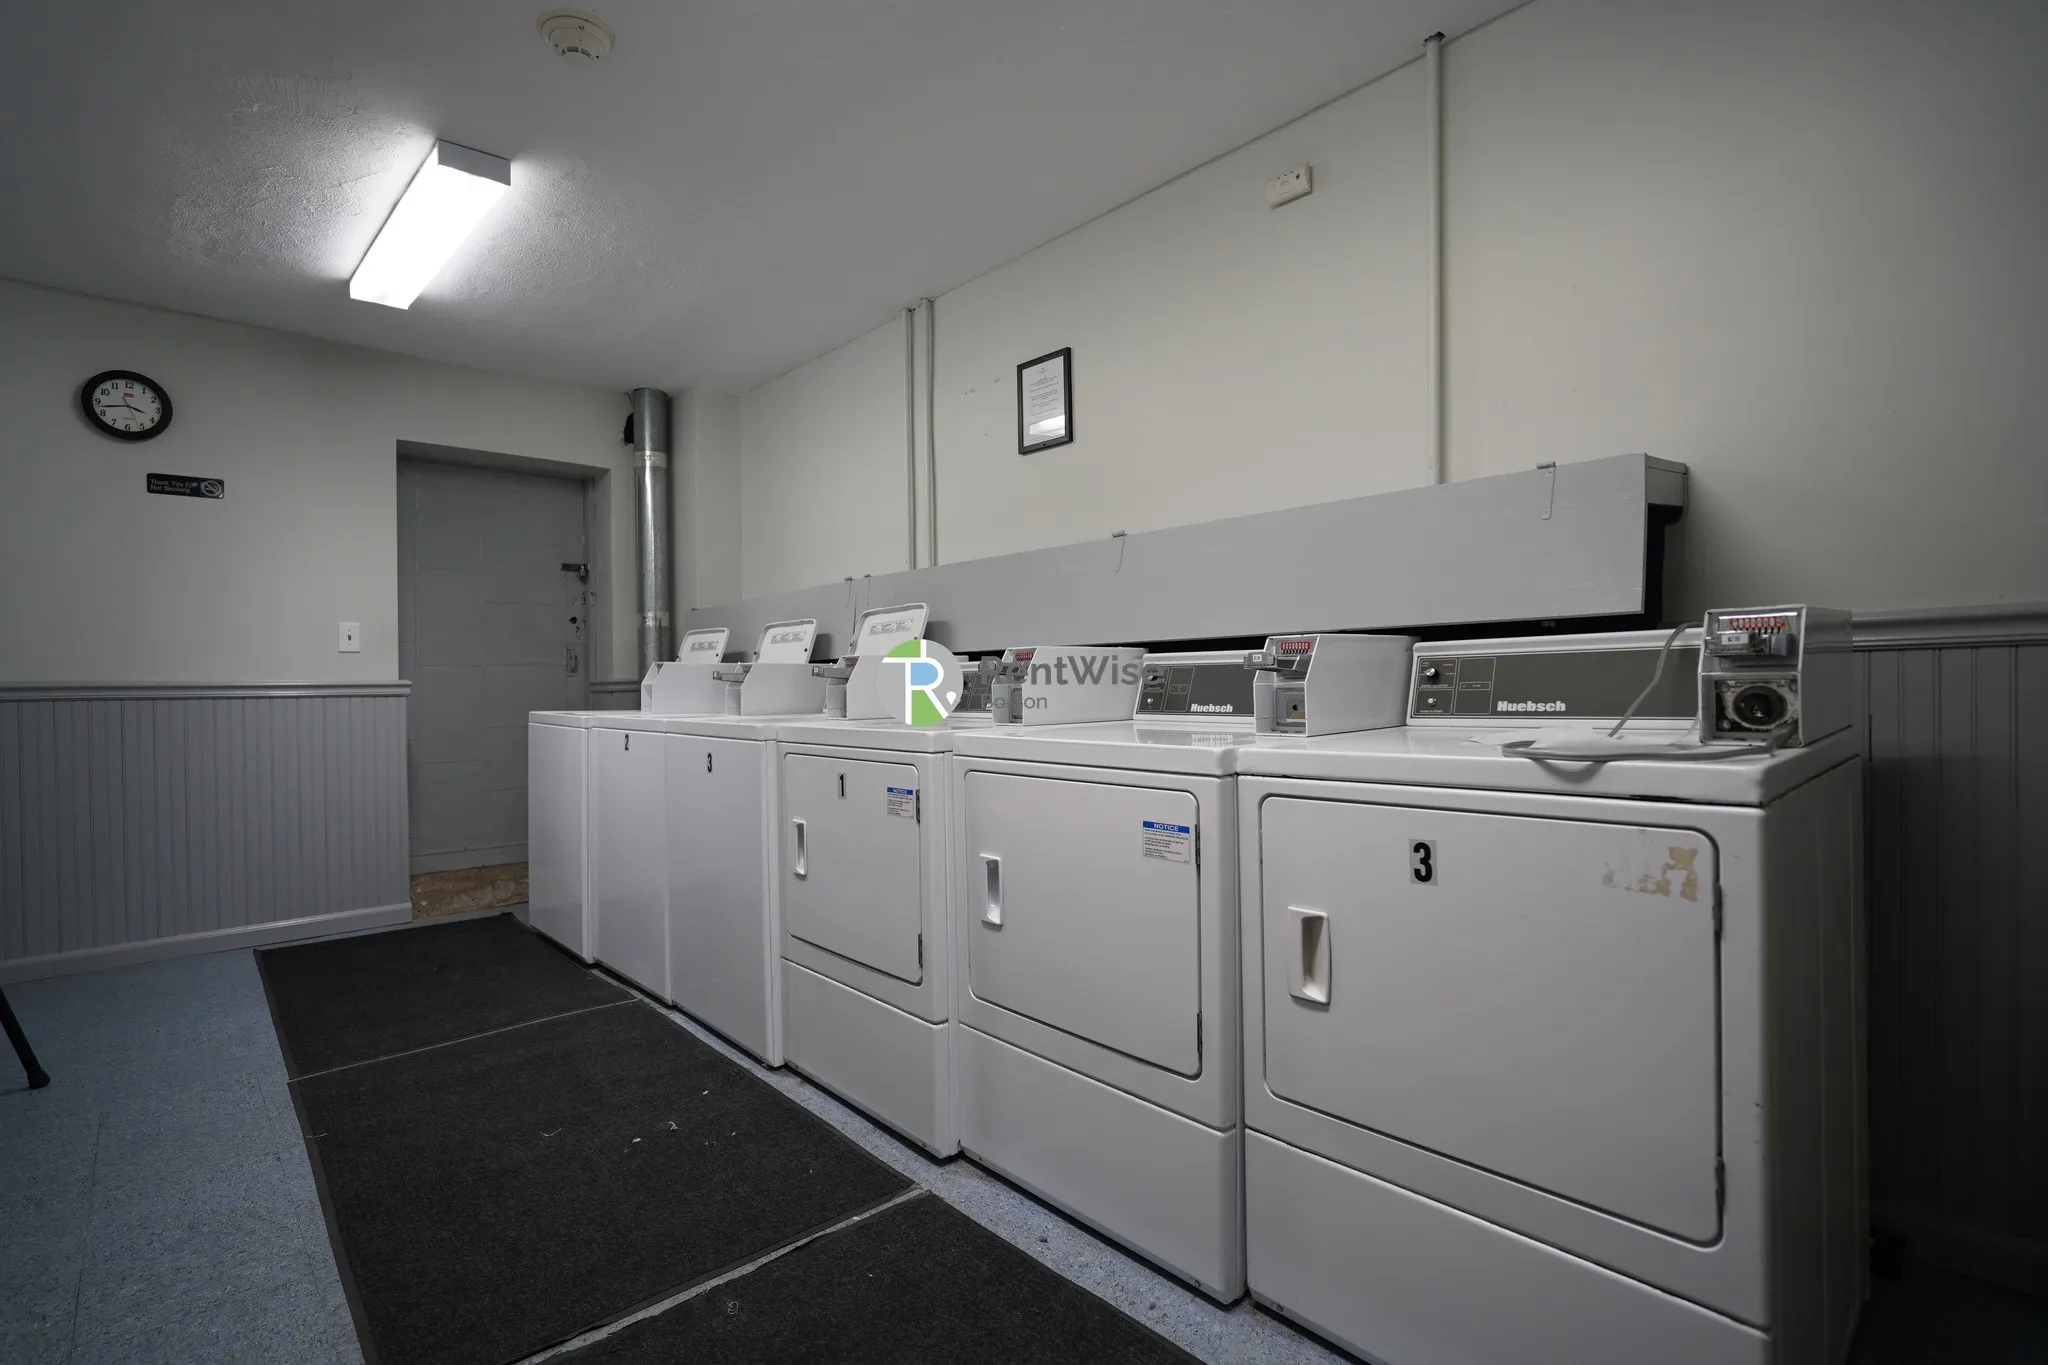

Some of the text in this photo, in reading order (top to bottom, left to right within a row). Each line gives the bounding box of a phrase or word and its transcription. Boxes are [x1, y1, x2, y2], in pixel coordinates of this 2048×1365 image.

[111, 382, 118, 390] 11
[125, 381, 134, 389] 12
[101, 388, 109, 396] 10
[112, 418, 117, 426] 7
[163, 486, 191, 494] Smoking
[1190, 703, 1233, 713] Huebsch
[1497, 700, 1566, 712] Huebsch
[625, 734, 629, 751] 2
[707, 752, 712, 773] 3
[840, 774, 844, 797] 1
[1153, 823, 1179, 832] NOTICE
[1413, 842, 1433, 883] 3
